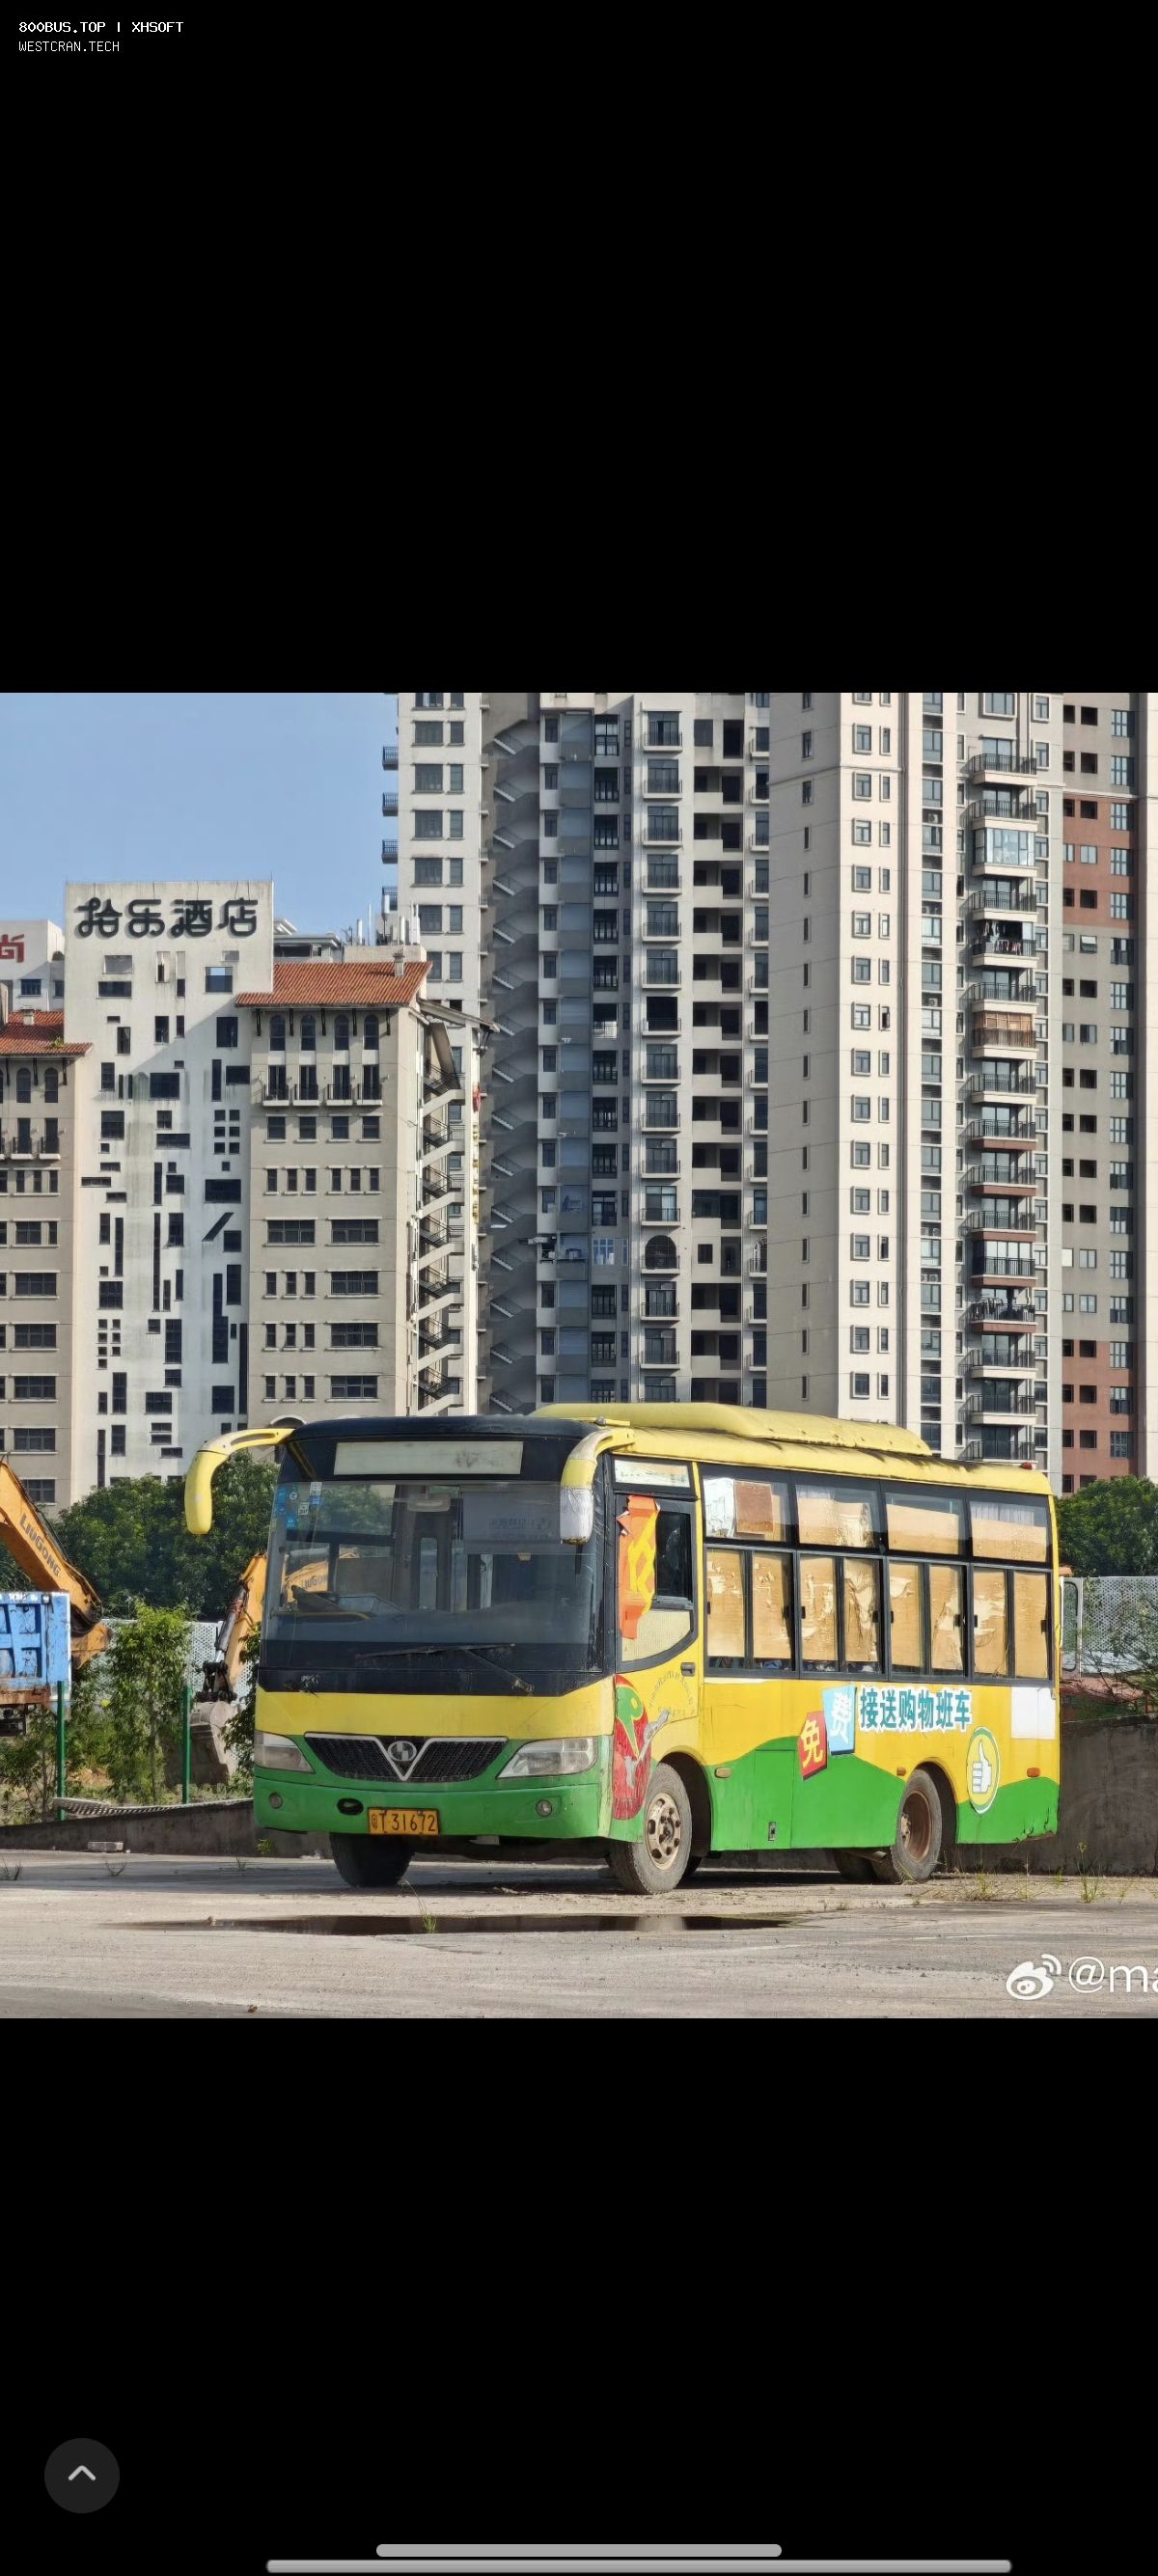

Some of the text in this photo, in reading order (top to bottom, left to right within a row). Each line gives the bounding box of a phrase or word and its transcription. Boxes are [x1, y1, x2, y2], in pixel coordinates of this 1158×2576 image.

[75, 896, 259, 938] 拾乐酒店
[18, 1512, 62, 1577] LIUGONG
[859, 1687, 972, 1730] 接送购物班车
